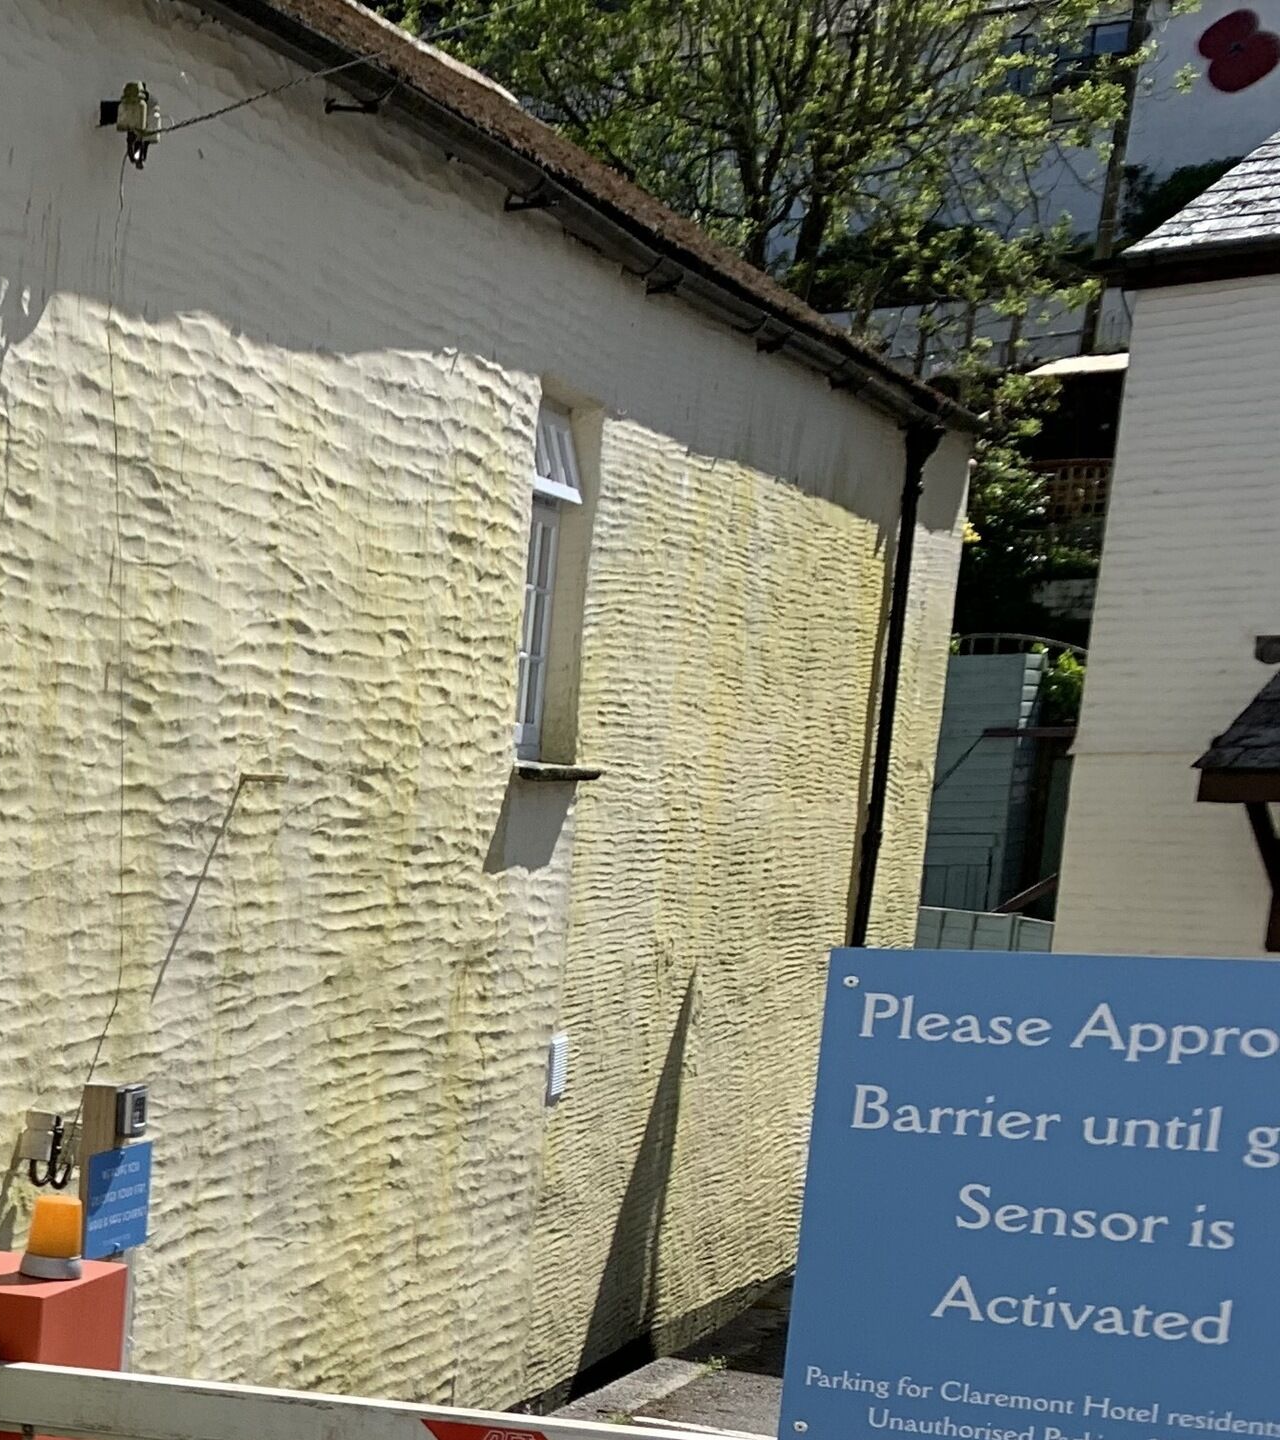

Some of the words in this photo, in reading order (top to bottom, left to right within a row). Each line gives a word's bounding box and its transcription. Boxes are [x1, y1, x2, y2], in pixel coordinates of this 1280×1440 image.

[859, 992, 1052, 1047] Please
[850, 1084, 1062, 1141] Barrier
[1082, 1105, 1223, 1152] until
[956, 1183, 1169, 1243] Sensor
[1188, 1204, 1236, 1250] is
[931, 1275, 1233, 1345] Activated
[805, 1366, 890, 1399] Parking
[897, 1376, 933, 1398] for
[940, 1381, 1074, 1415] Claremont
[1083, 1395, 1159, 1424] Hotel
